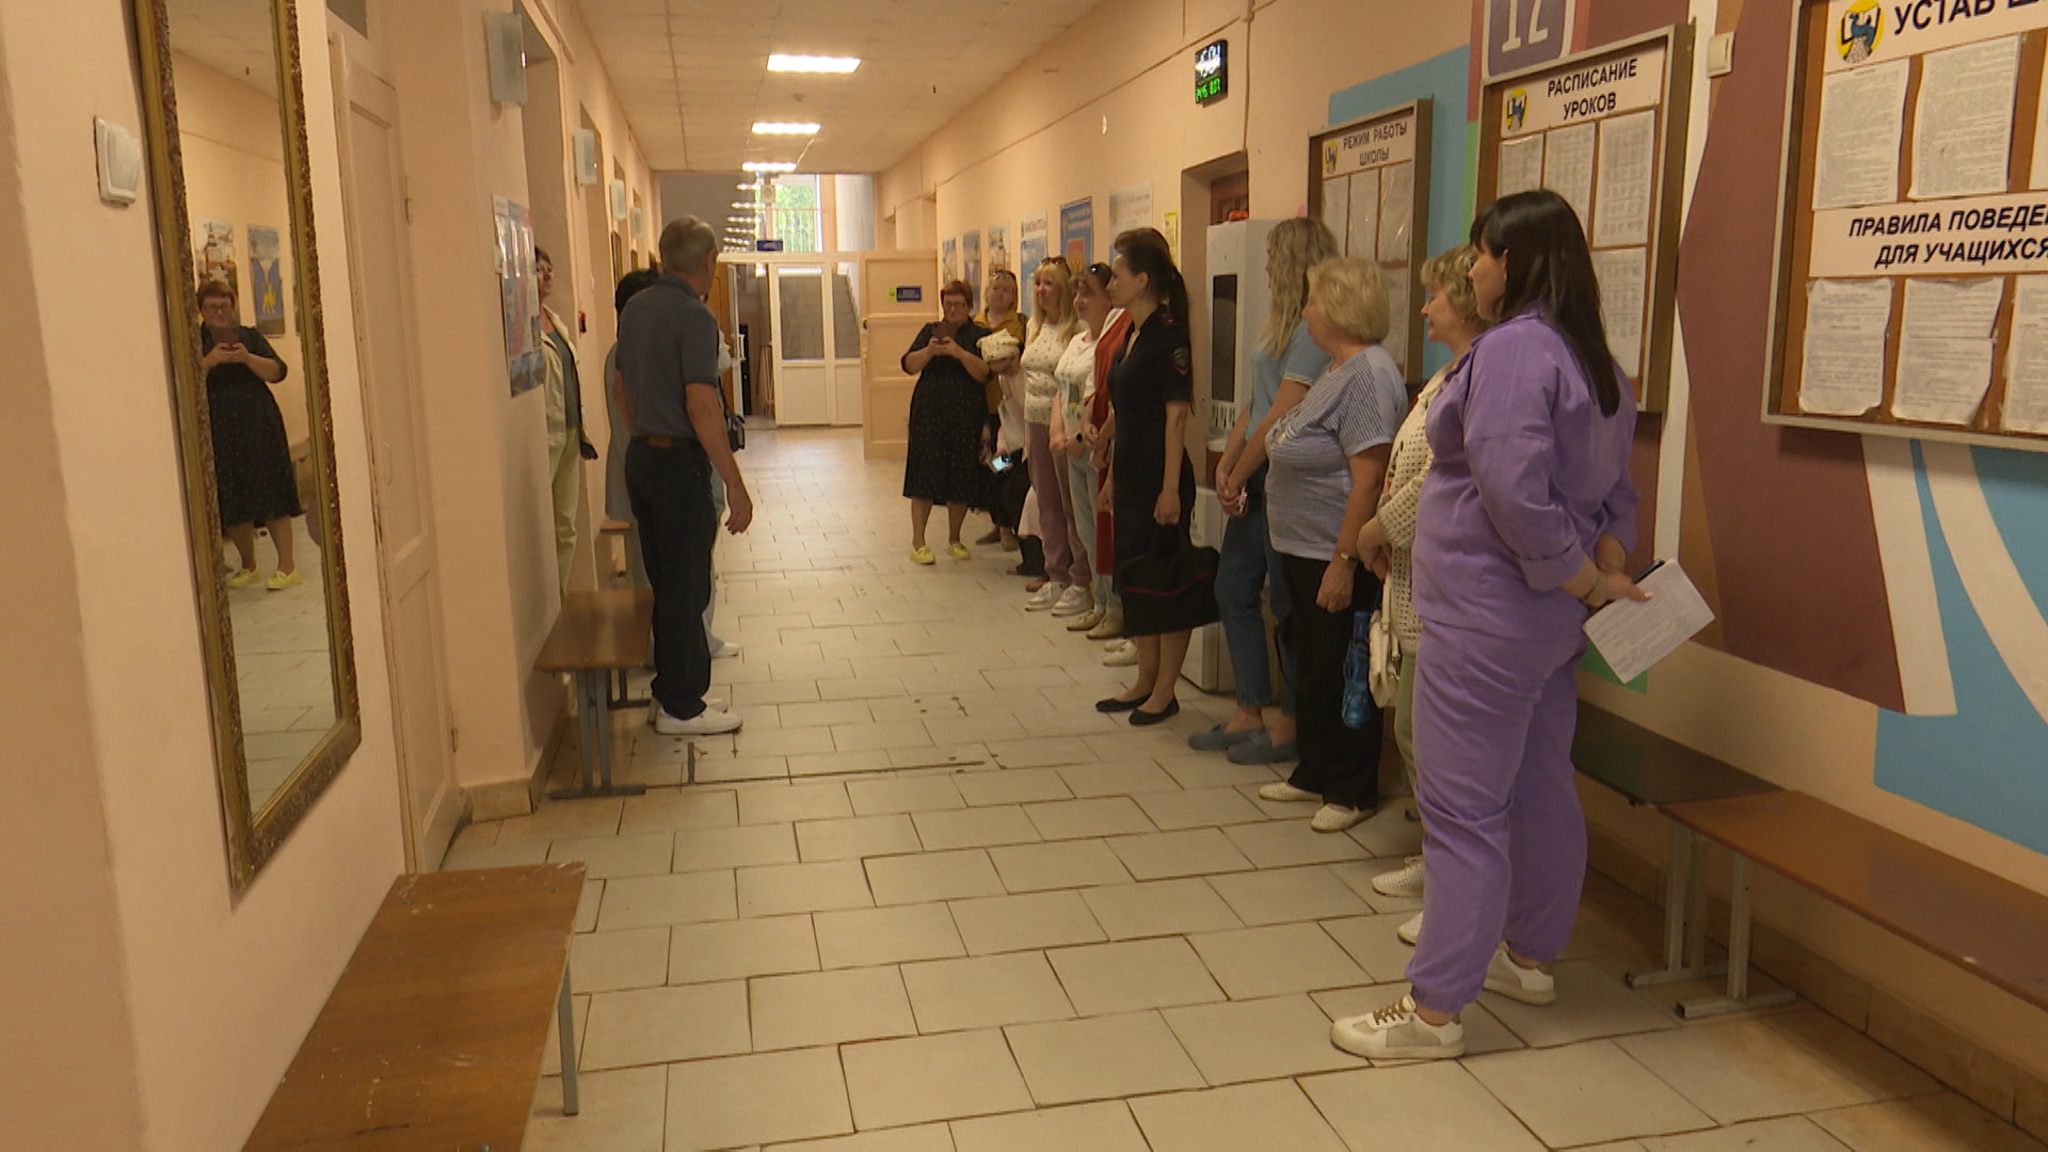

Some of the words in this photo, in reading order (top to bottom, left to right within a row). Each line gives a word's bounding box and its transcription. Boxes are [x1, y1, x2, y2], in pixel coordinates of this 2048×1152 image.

[1894, 0, 1995, 35] УСТАВ
[1547, 58, 1637, 97] РАСПИСАНИЕ
[1563, 91, 1616, 120] УРОКОВ
[1343, 131, 1370, 151] РЕЖИМ
[1373, 121, 1407, 142] РАБОТЫ
[1359, 147, 1389, 166] ШКОЛЫ
[1848, 212, 1941, 237] ПРАВИЛА
[1948, 204, 2048, 232] ПОВЕДЕ
[1874, 244, 1919, 269] ДЛЯ
[1923, 237, 2048, 266] УЧАЩИХСЯ
